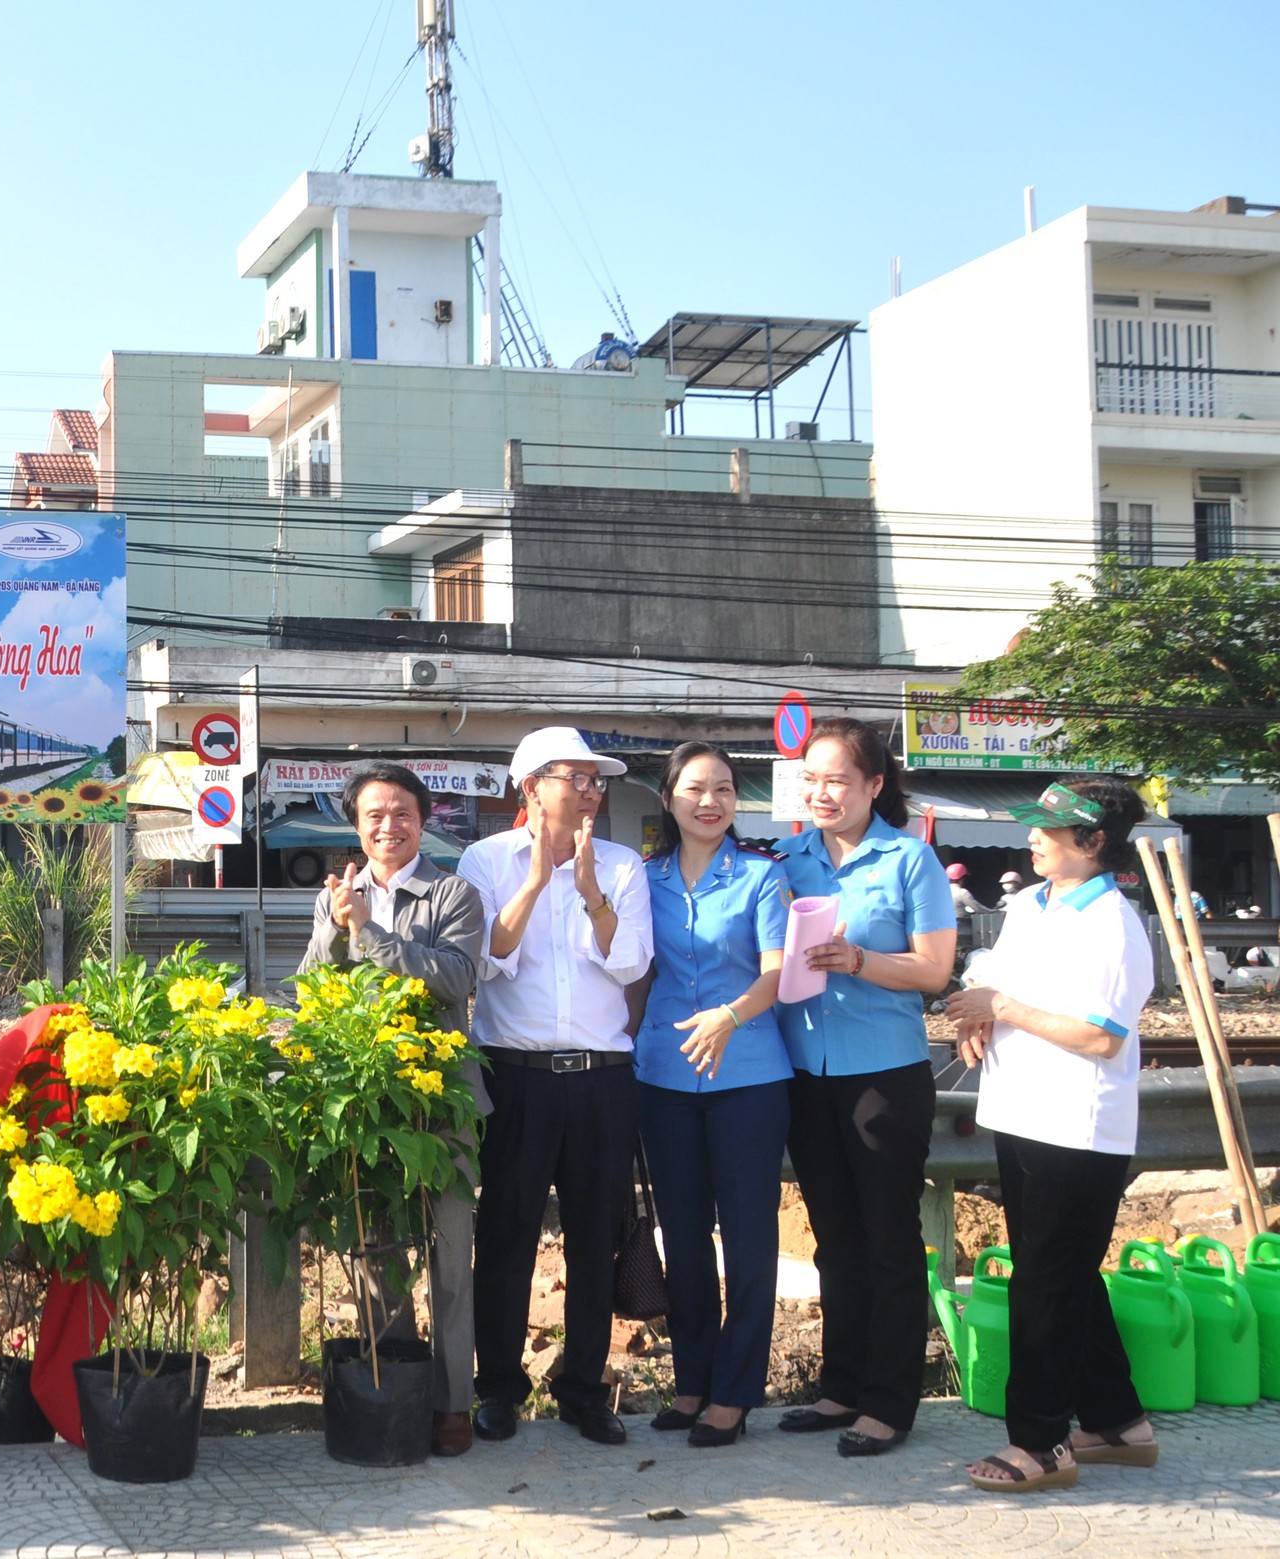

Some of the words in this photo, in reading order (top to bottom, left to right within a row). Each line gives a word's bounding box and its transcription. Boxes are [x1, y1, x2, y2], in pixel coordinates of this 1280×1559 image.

[14, 577, 39, 591] QUẢNG
[41, 581, 59, 591] NAM
[66, 579, 76, 591] ĐÀ
[921, 735, 969, 750] XƯƠNG
[983, 735, 1005, 751] TÁI
[944, 757, 958, 767] GIA
[204, 769, 230, 782] ZONE
[276, 763, 304, 780] HẢI
[423, 775, 448, 790] TAY
[451, 776, 467, 791] GA
